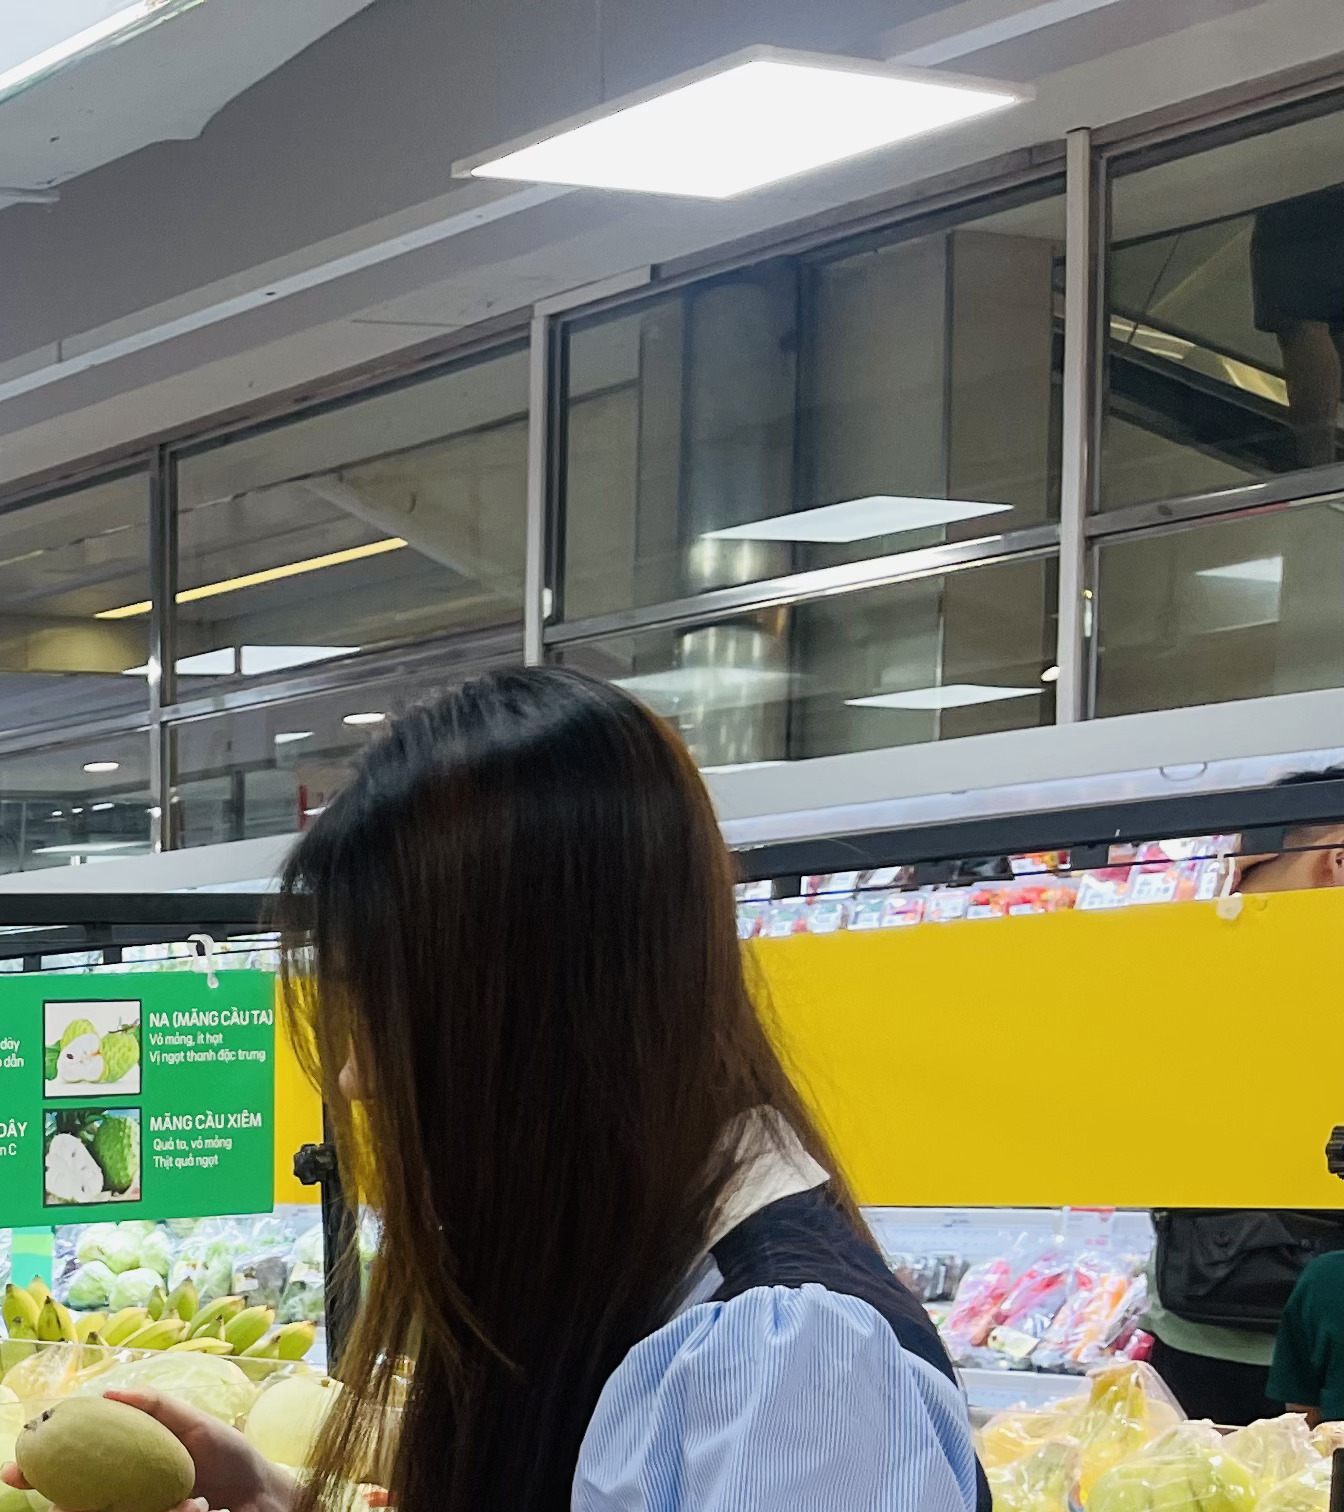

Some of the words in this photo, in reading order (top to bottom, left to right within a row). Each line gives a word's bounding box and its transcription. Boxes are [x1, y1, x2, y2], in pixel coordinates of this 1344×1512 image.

[149, 1012, 170, 1028] NA
[250, 1008, 273, 1026] TA)
[206, 1032, 223, 1047] hạt
[149, 1050, 160, 1066] Vị
[161, 1050, 185, 1065] ngọt
[186, 1049, 216, 1062] thanh
[149, 1112, 193, 1131] MÃNG
[194, 1109, 225, 1130] CẦU
[227, 1109, 263, 1128] XIÊM
[8, 1142, 17, 1156] C
[153, 1137, 174, 1151] Quả
[175, 1138, 189, 1151] to,
[153, 1154, 173, 1170] Thịt
[195, 1154, 219, 1169] ngọt
